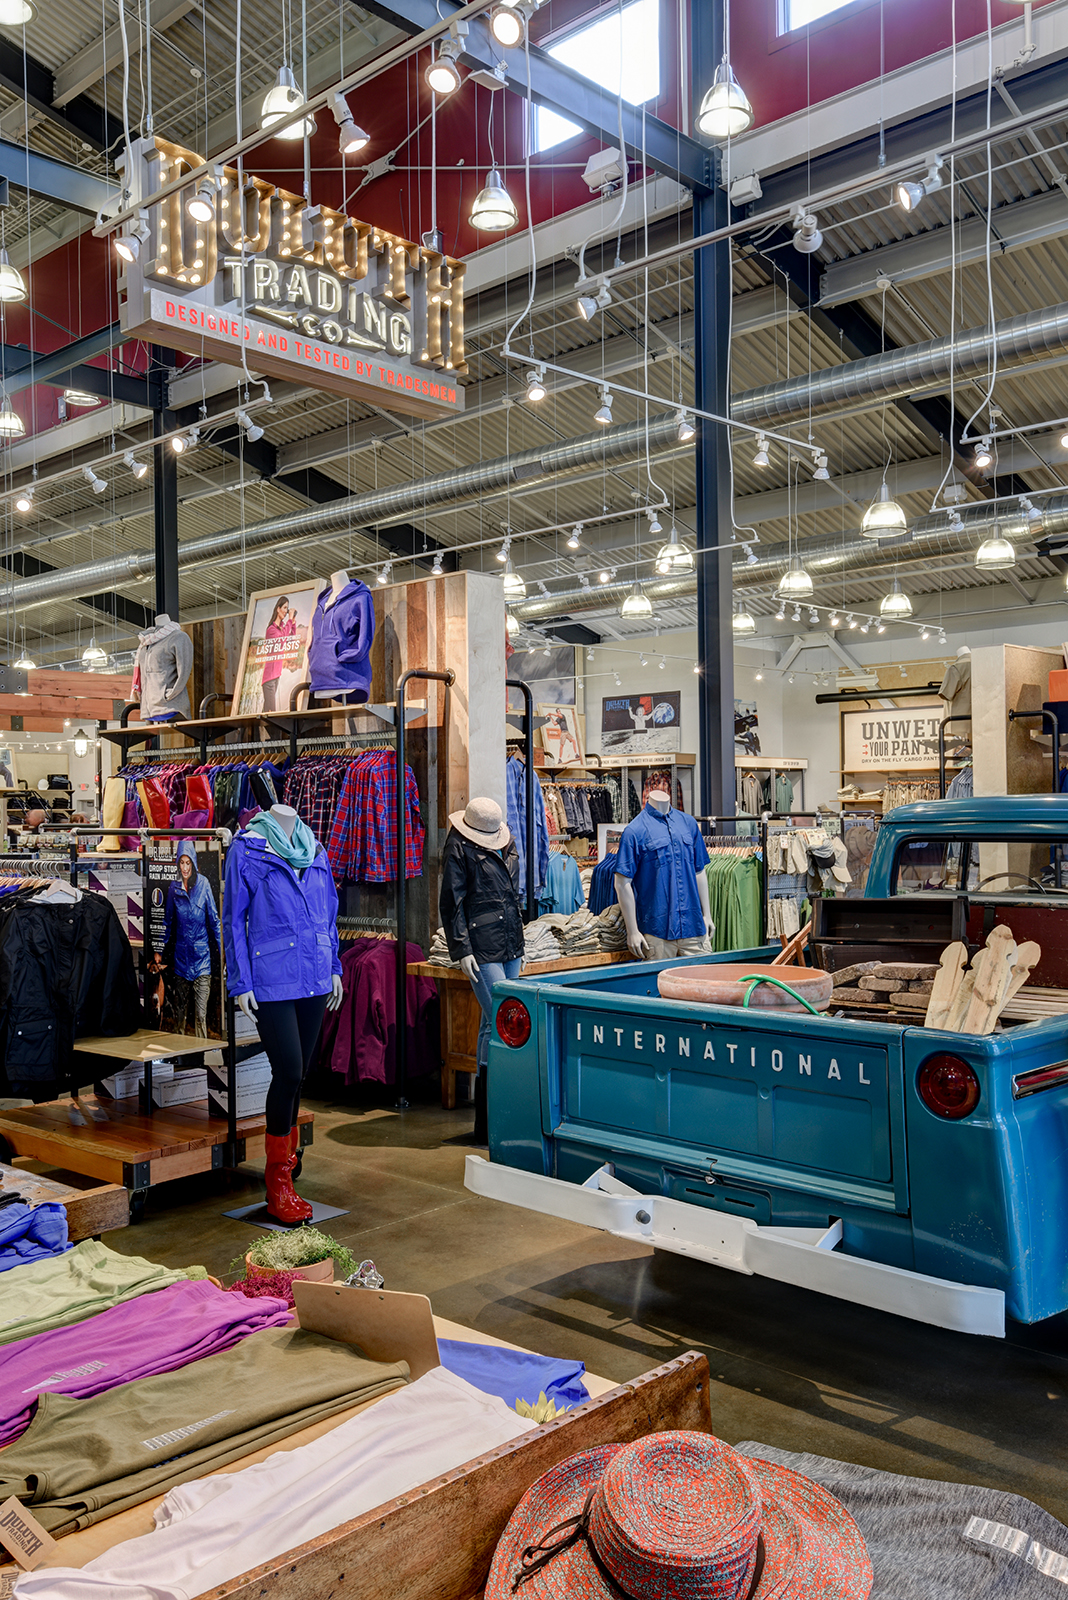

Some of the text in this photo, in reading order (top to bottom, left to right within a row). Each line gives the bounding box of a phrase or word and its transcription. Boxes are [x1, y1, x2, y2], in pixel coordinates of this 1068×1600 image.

[146, 136, 468, 376] DULUTH
[223, 257, 412, 355] TRADING
[165, 300, 456, 404] DESIGNED AND TESTED BY TRADESMEN
[256, 640, 300, 655] LAST BLASTS
[861, 718, 940, 740] UNWET
[869, 739, 940, 756] YOUR PAN
[164, 865, 177, 873] STOP
[577, 1022, 871, 1085] INTERNATIONAL
[0, 1509, 43, 1557] DULUTH
[5, 1525, 28, 1550] TRADING
